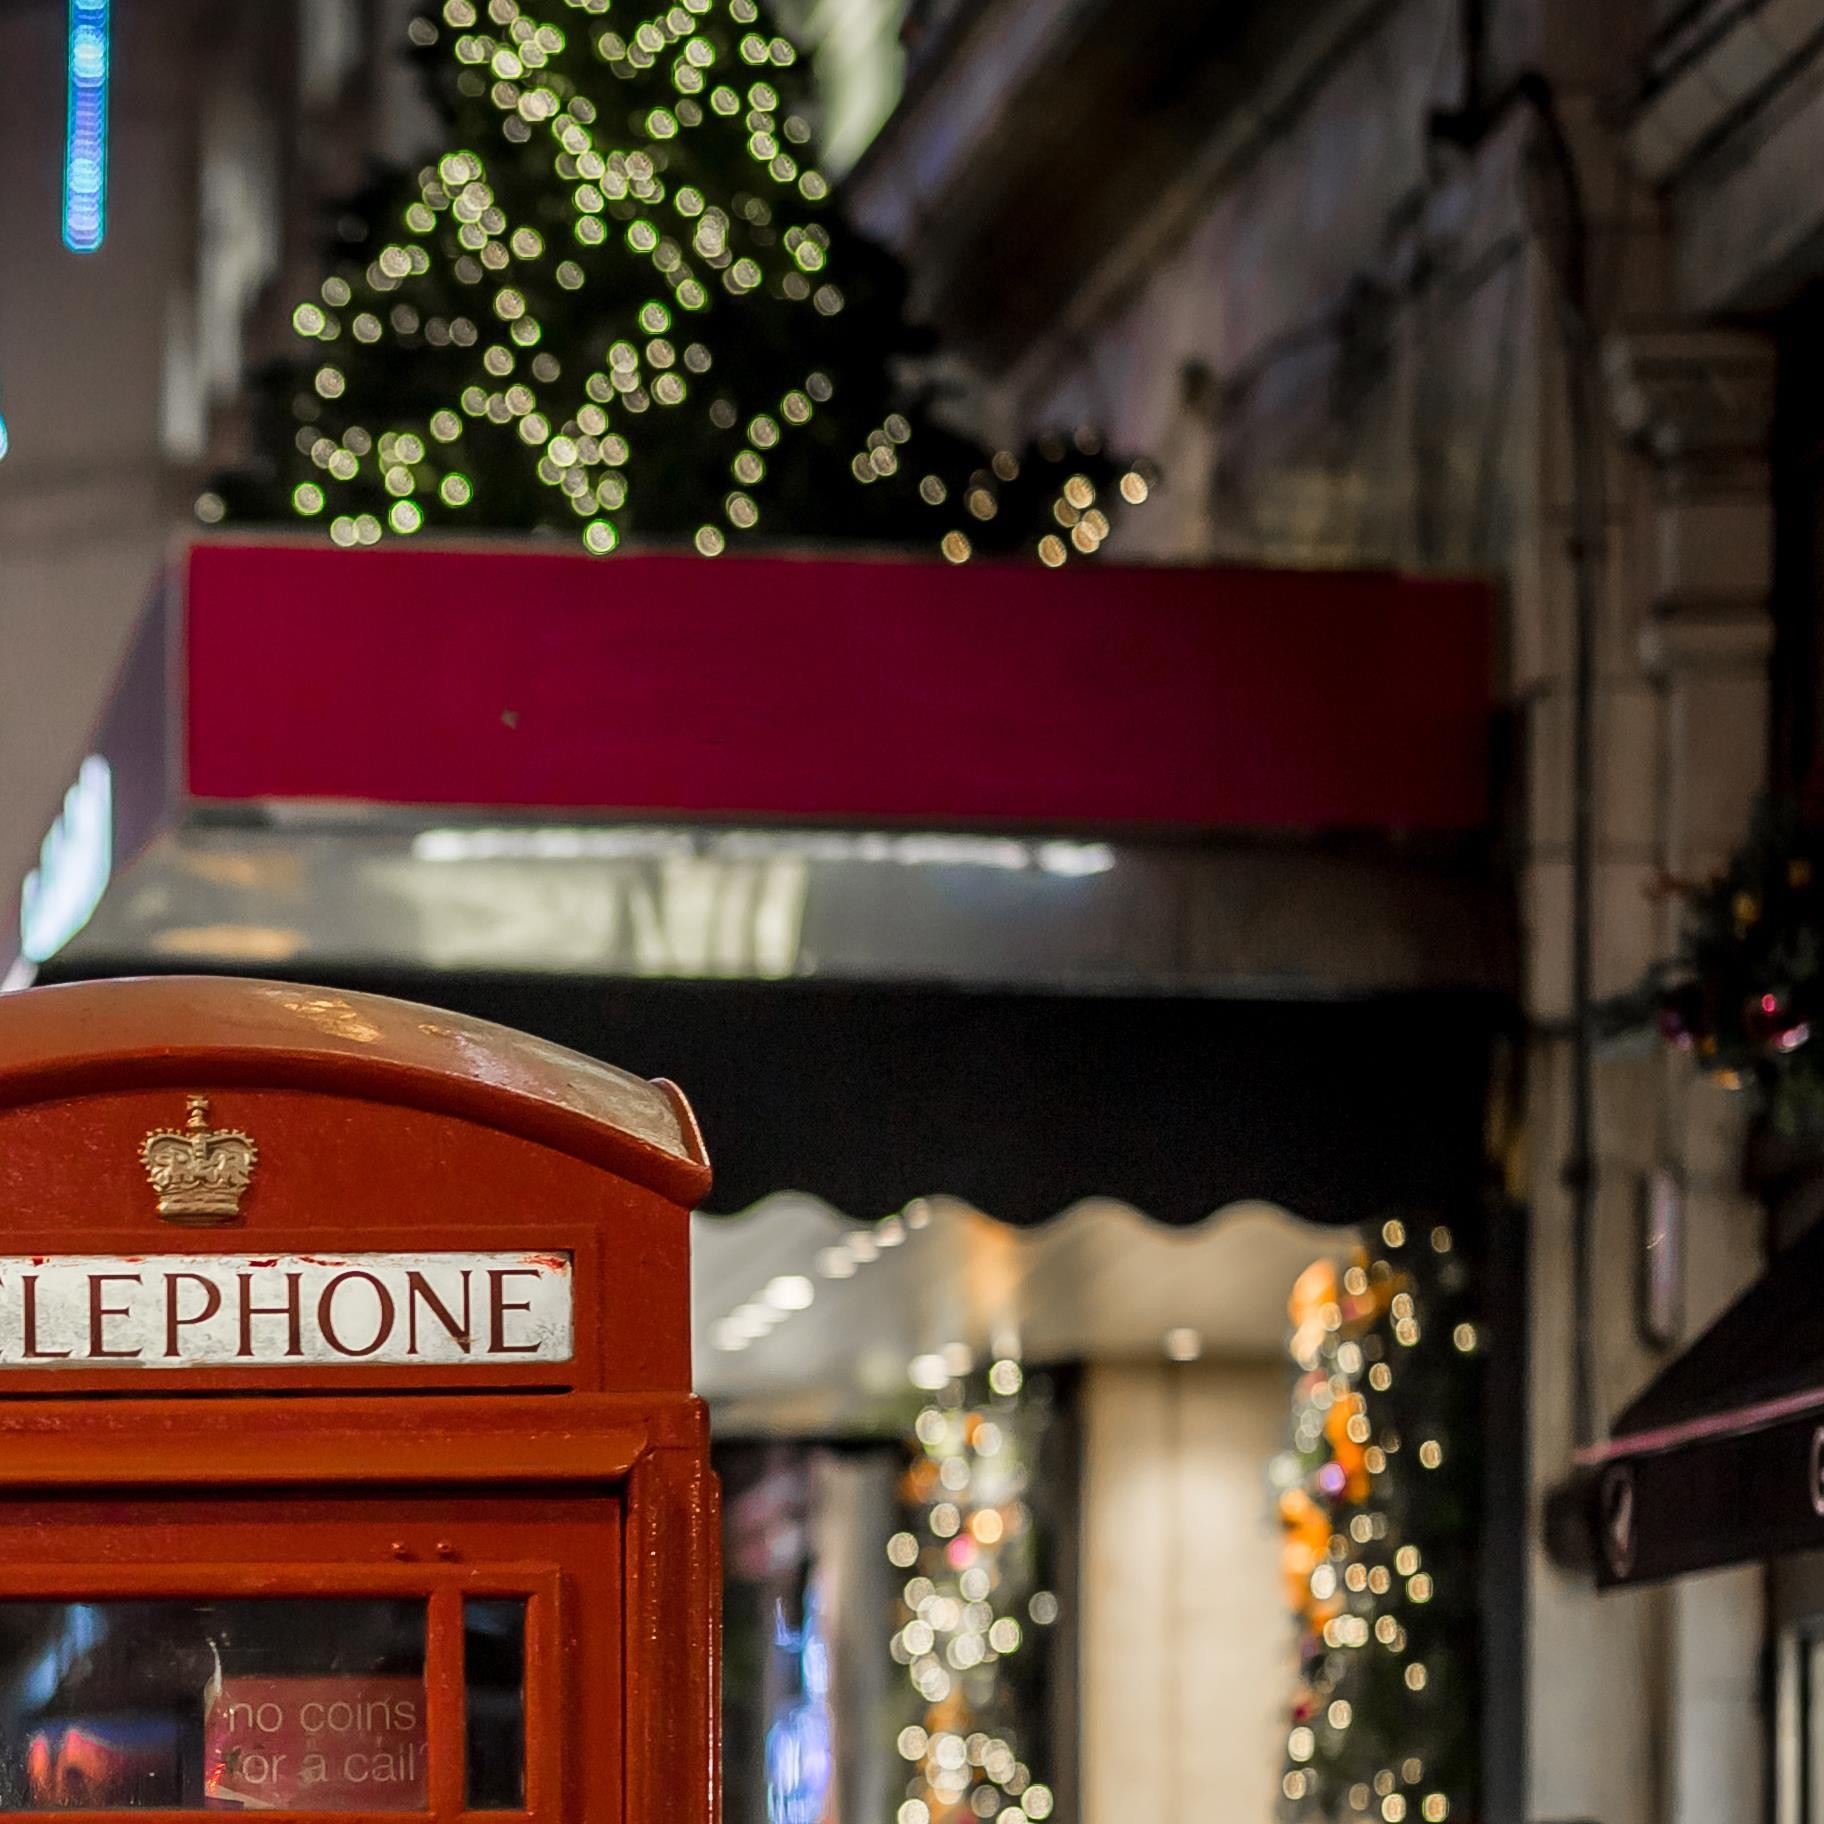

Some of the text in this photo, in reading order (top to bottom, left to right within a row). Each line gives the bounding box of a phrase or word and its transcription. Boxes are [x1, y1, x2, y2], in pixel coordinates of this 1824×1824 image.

[229, 1694, 417, 1733] no coins
[302, 1753, 329, 1783] a
